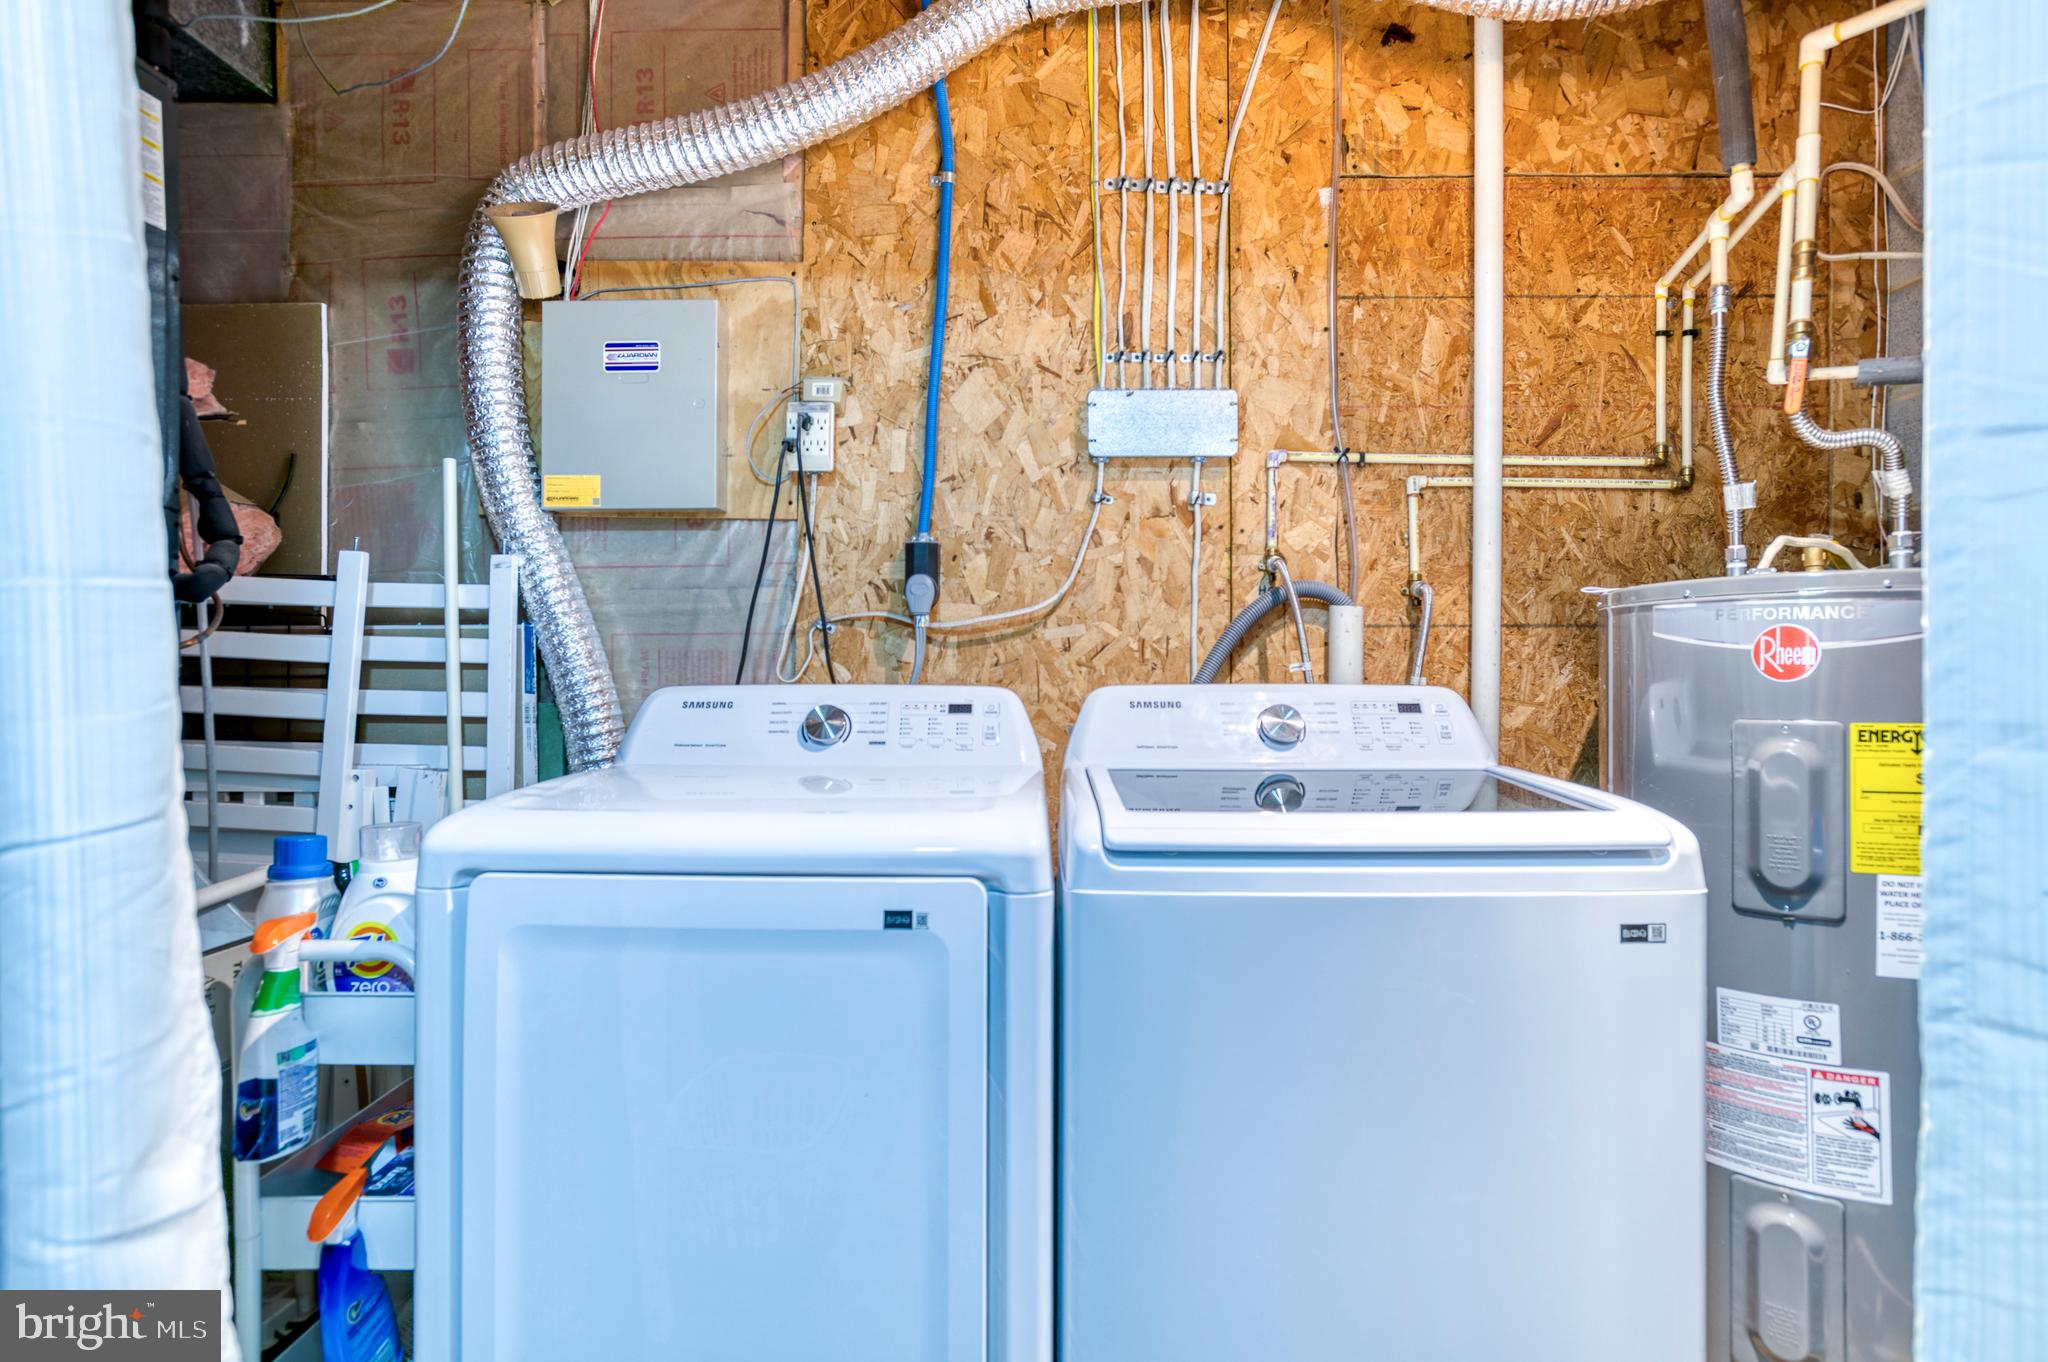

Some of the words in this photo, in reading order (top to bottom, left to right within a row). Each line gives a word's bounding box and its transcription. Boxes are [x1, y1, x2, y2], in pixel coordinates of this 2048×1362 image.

[1715, 605, 1869, 621] PERFORMANCE
[1759, 626, 1817, 673] Rheem
[682, 700, 734, 709] SAMSUNG
[1129, 700, 1182, 709] SAMSUNG
[1858, 729, 1922, 749] ENERGY
[1880, 890, 1909, 898] WATER
[350, 980, 391, 992] zero
[1825, 1071, 1878, 1086] DANGER
